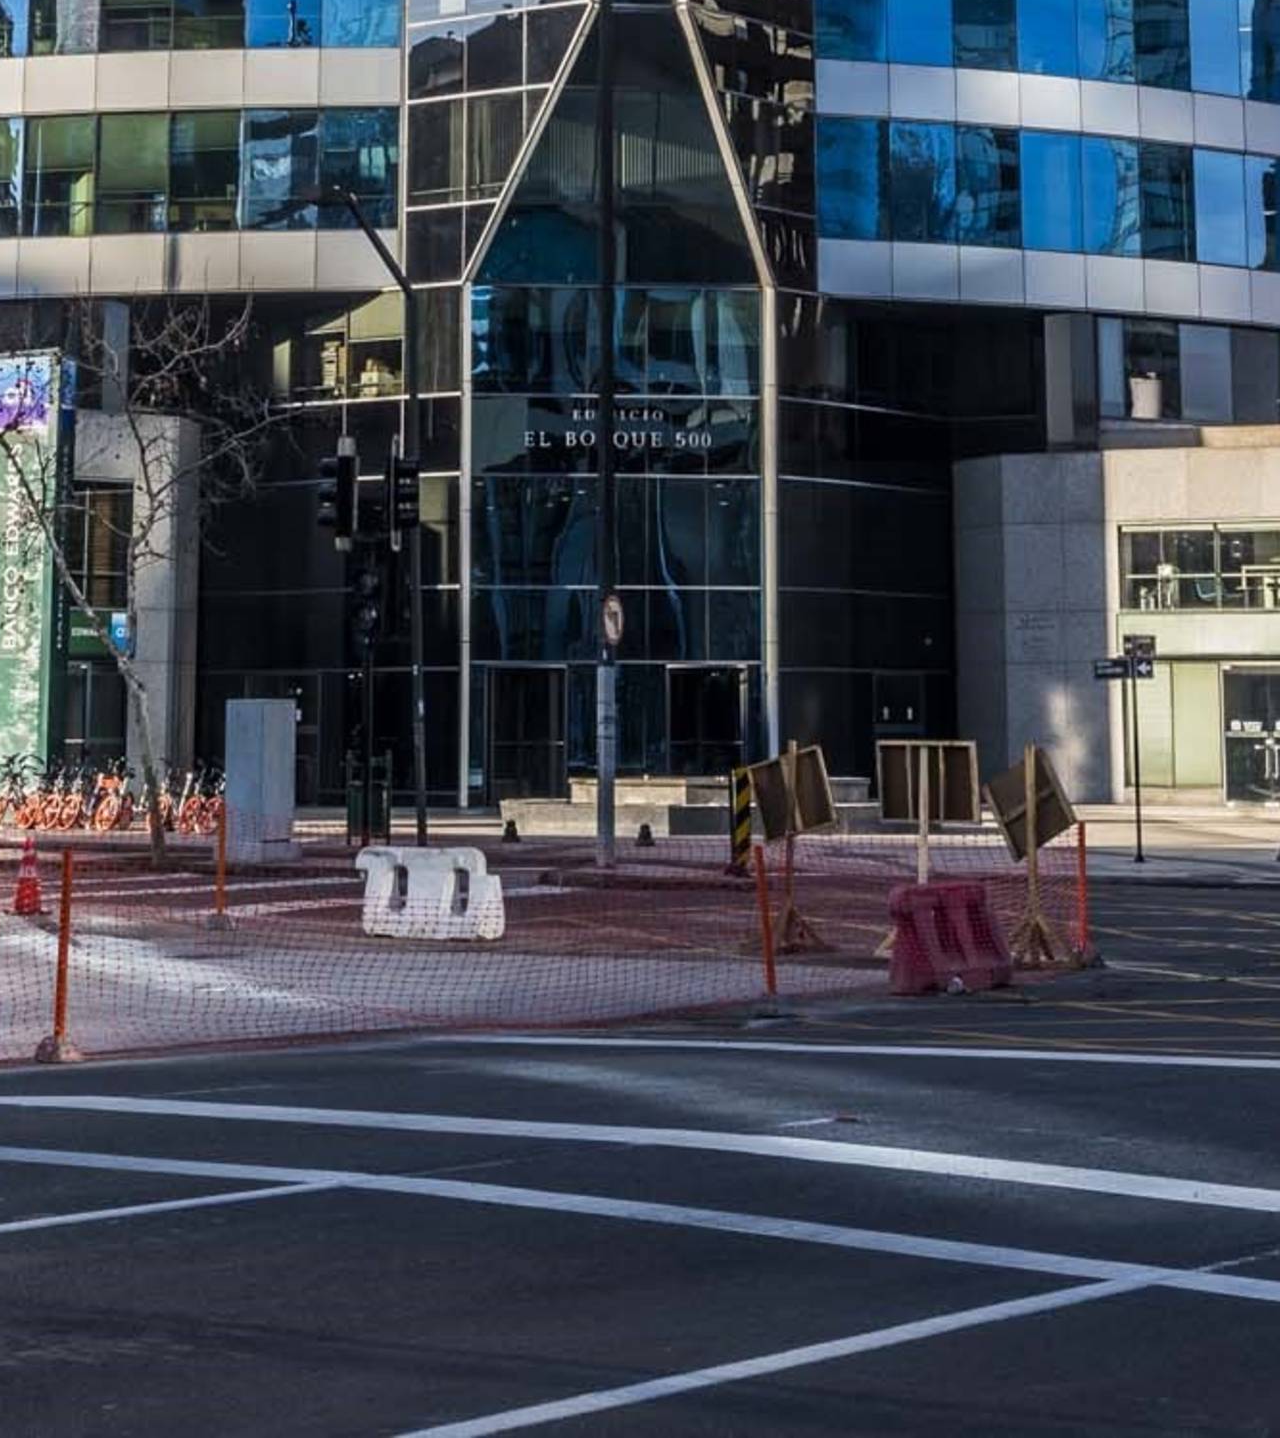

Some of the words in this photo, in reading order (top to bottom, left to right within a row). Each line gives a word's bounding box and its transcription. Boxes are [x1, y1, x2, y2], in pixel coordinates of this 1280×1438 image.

[572, 410, 663, 421] EDICIO
[524, 431, 551, 447] EL
[565, 430, 663, 448] BOQUE
[675, 432, 712, 448] 500
[2, 566, 19, 649] BANCO
